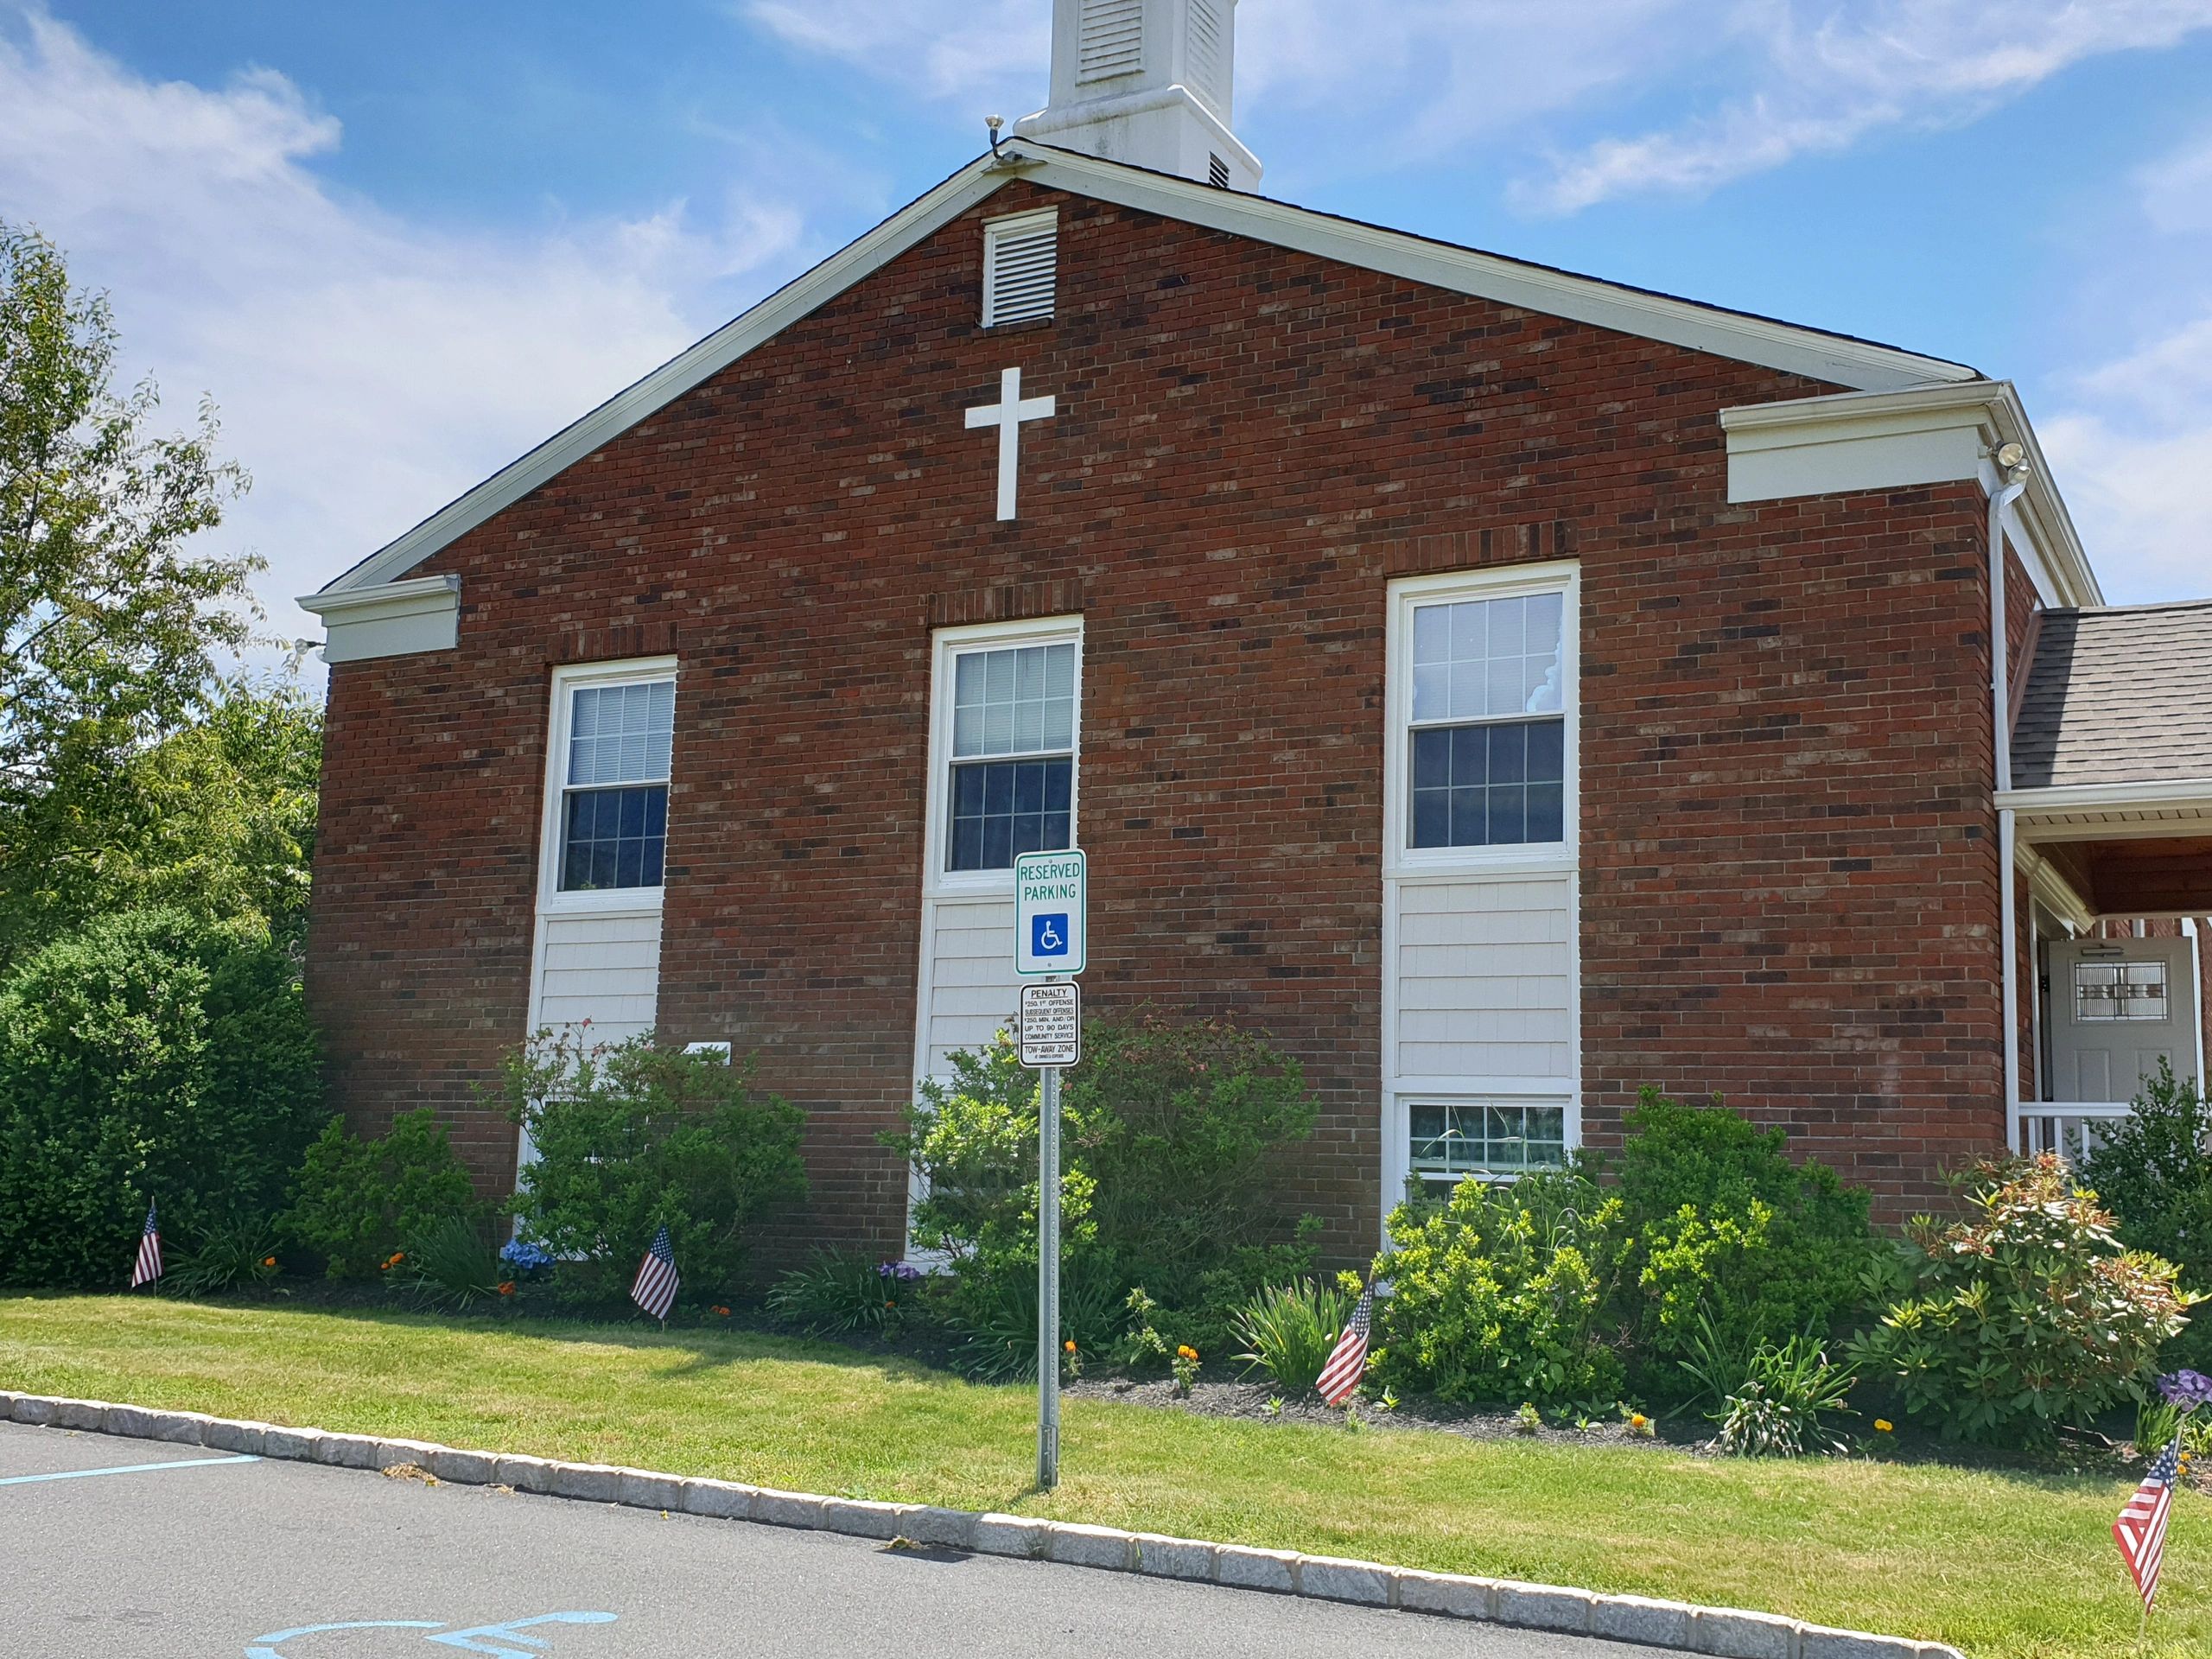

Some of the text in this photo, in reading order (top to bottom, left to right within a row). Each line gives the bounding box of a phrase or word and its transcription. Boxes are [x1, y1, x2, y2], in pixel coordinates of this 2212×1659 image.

[1020, 862, 1080, 880] RESERVED
[1024, 883, 1076, 901] PARKING
[1031, 988, 1067, 998] PENALTY
[1024, 1044, 1074, 1054] TOW-AWAY ZONE
